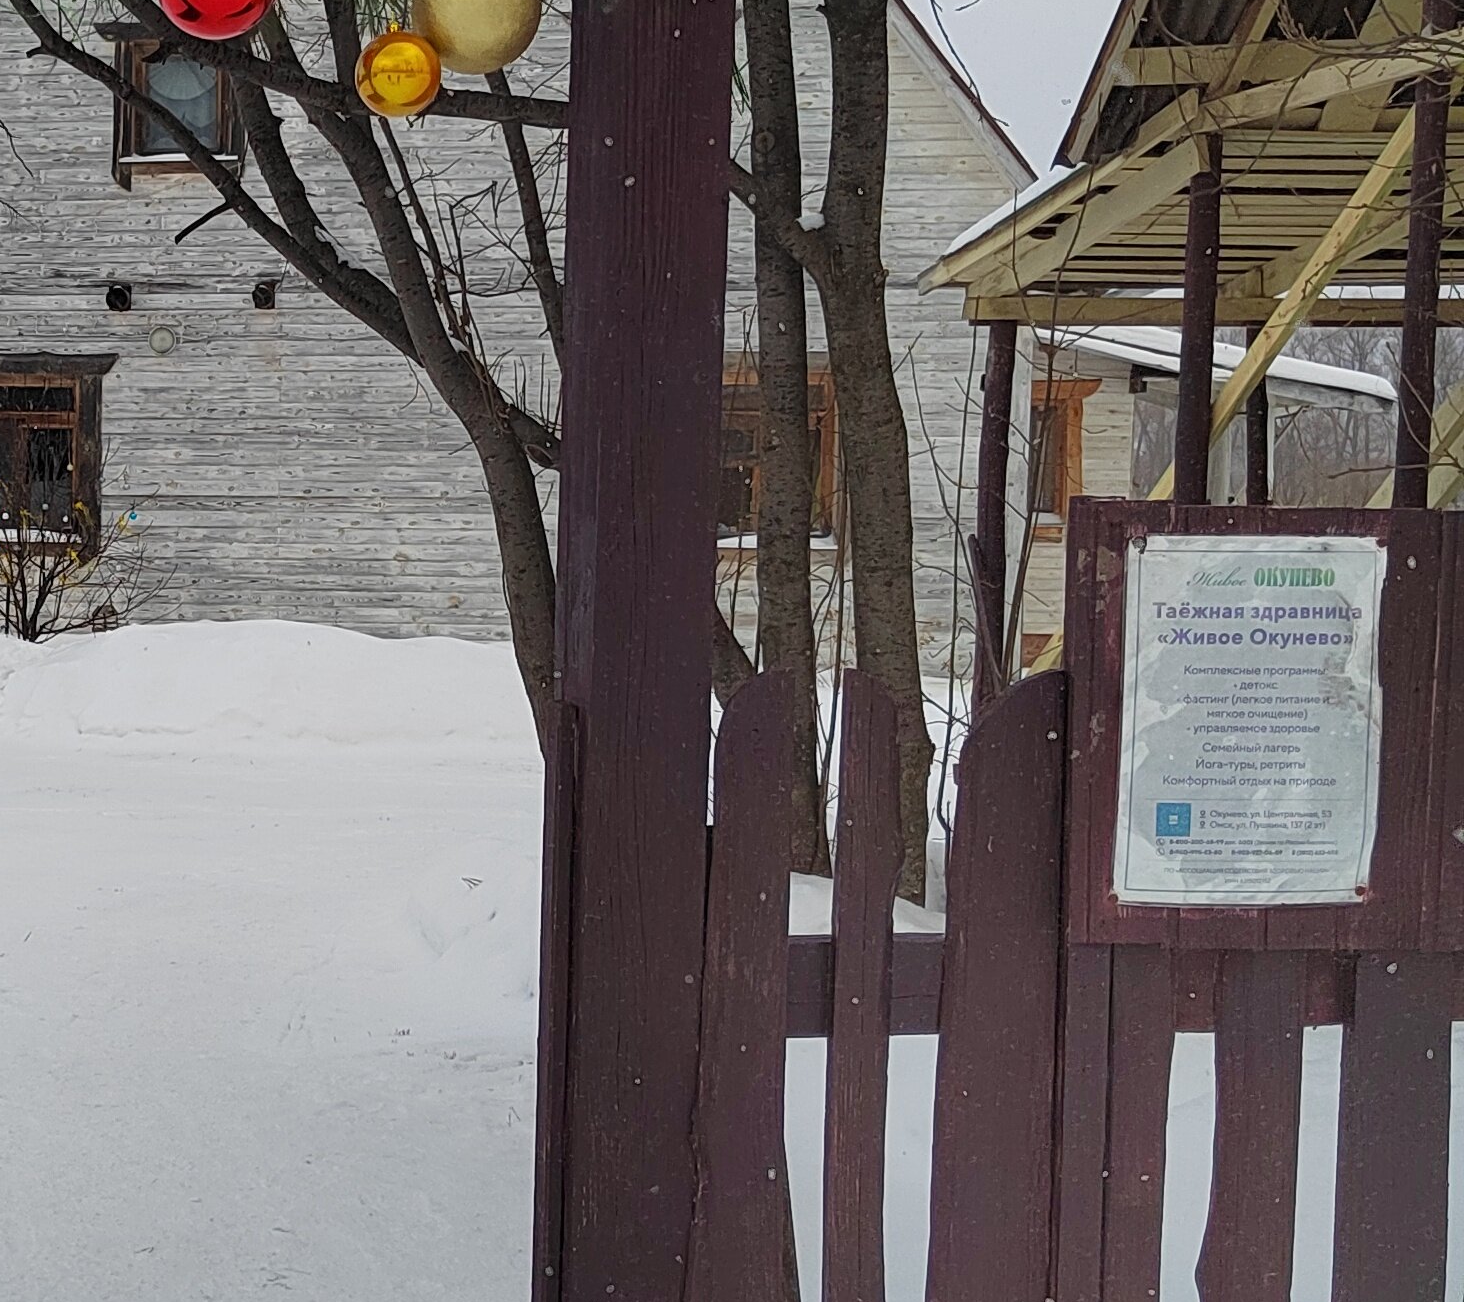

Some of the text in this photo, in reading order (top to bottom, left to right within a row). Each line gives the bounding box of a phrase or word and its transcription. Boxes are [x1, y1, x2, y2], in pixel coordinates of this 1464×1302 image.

[1153, 602, 1363, 623] Таёжная здравница
[1158, 628, 1354, 649] «Живое Окунево»
[1184, 666, 1261, 675] Комплексные
[1240, 682, 1278, 690] детокс
[1183, 695, 1229, 705] фастинг
[1231, 695, 1273, 706] (легкое
[1275, 696, 1320, 704] питание
[1247, 709, 1308, 720] очищение)
[1194, 725, 1320, 734] управляемое здоровье
[1202, 742, 1301, 754] Семейный лагерь
[1196, 757, 1305, 771] Йога-туры, ретриты
[1163, 775, 1236, 787] Комфортный
[1239, 778, 1271, 787] отдых
[1289, 778, 1336, 787] природе
